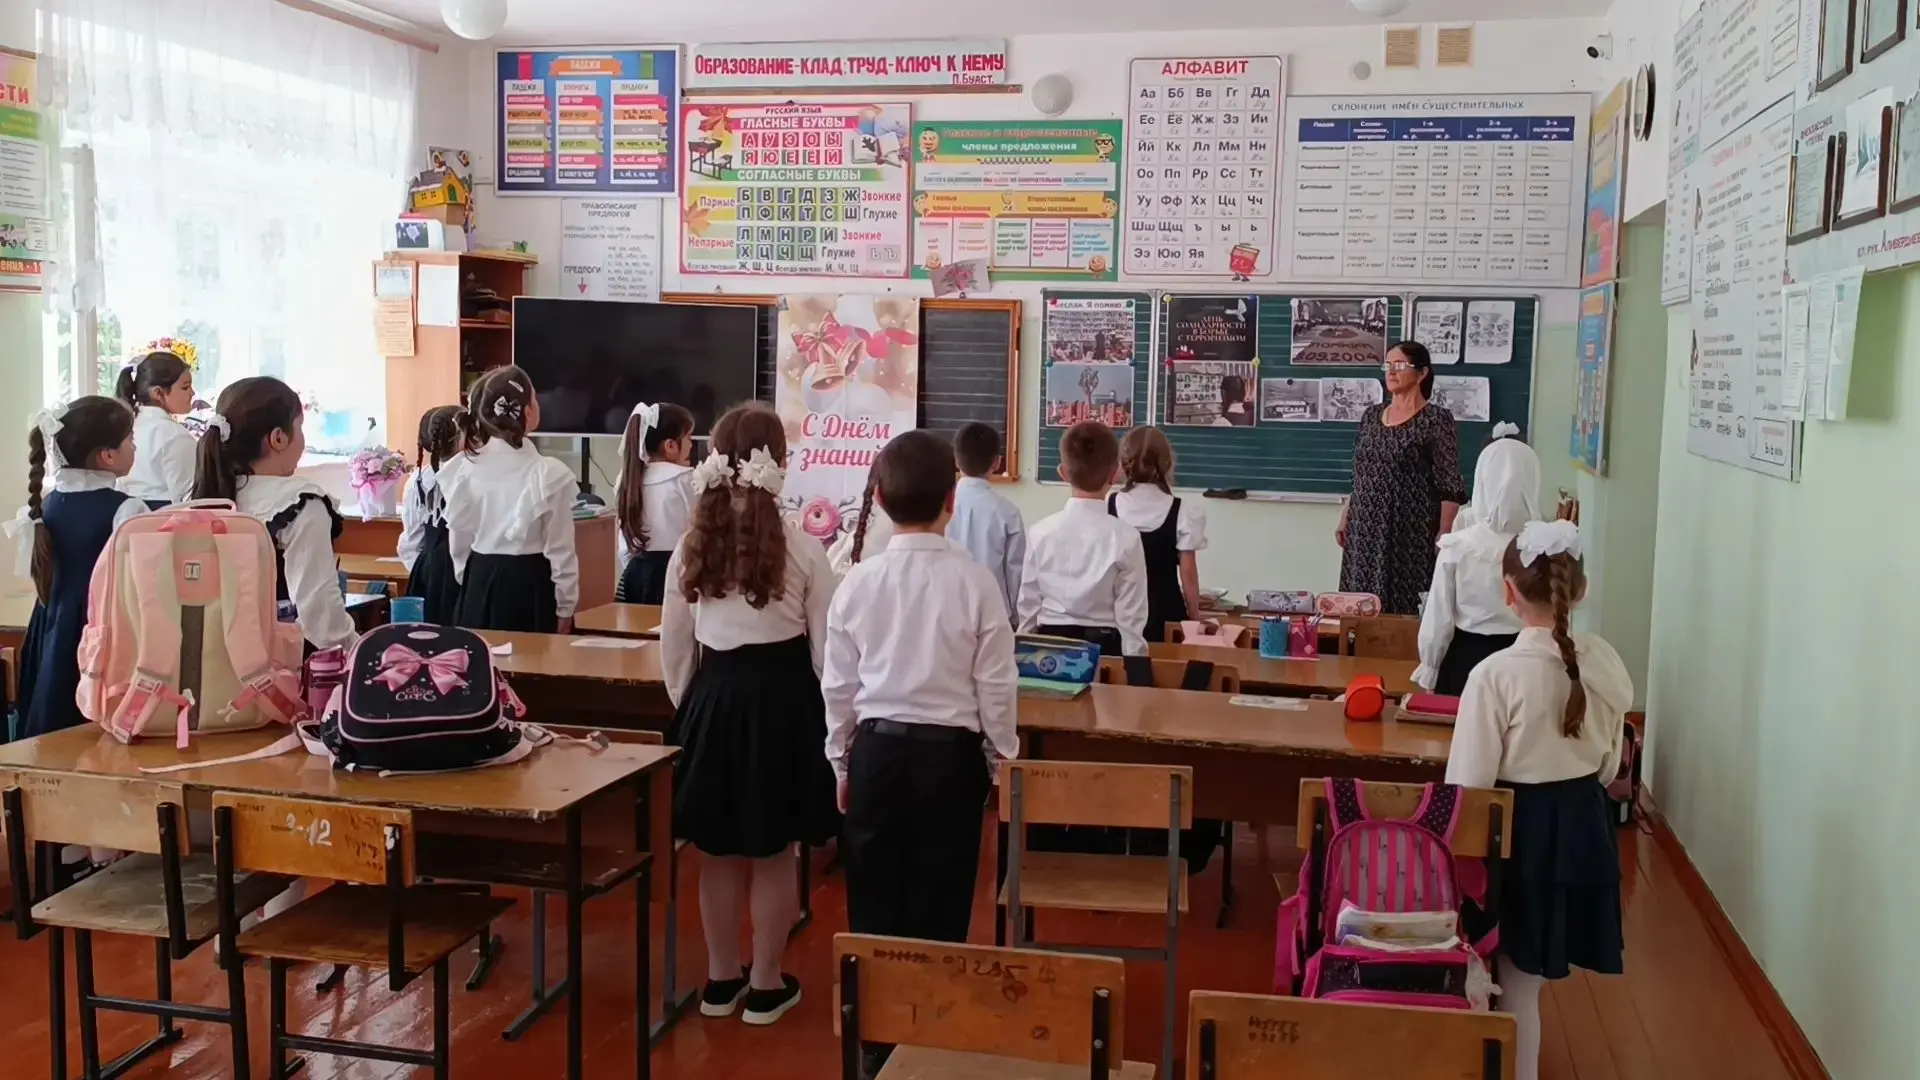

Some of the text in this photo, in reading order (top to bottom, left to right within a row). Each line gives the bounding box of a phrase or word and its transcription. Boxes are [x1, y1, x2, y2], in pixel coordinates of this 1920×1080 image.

[947, 54, 956, 72] К
[1161, 60, 1249, 76] АЛФАВИТ
[1140, 87, 1270, 99] Аа Бб Вв Гг Дд
[765, 107, 799, 115] РУССКИЙ
[1331, 101, 1524, 111] СКЛОНЕНИЕ ИМЁН СУЩЕСТВИТЕЛЬНЫХ
[740, 117, 845, 129] ГЛАСНЫЕ БУКВЫ
[1140, 115, 1155, 124] Ее
[1191, 114, 1214, 124] Жж
[1223, 114, 1239, 124] Зз
[1251, 114, 1268, 123] Ии
[961, 143, 1077, 152] члены предложения
[1167, 141, 1181, 151] Кк
[1193, 141, 1210, 151] Лл
[1219, 141, 1240, 151] Мм
[1249, 141, 1266, 151] Нн
[737, 169, 861, 181] СОГЛАСНЫЕ БУКВЫ
[1137, 168, 1263, 180] Оо Пп Рр Сс Тт
[844, 189, 858, 202] Ж
[861, 189, 902, 202] Звонкие
[1137, 195, 1262, 207] Уу Фф Хх Цц Чч
[581, 202, 637, 210] ПРАВОПИСАНИЕ
[700, 195, 736, 209] Парные
[588, 210, 631, 218] ПРЕДЛОГОВ
[844, 207, 858, 220] Ш
[863, 207, 898, 222] Глухие
[1132, 221, 1155, 231] Шш
[1159, 222, 1183, 233] Щщ
[842, 229, 882, 241] Звонкие
[688, 237, 735, 250] Непарные
[800, 247, 814, 261] Щ
[821, 246, 856, 261] Глухие
[1134, 248, 1204, 258] Ээ Юю Яя
[563, 265, 601, 275] ПРЕДЛОГИ
[801, 413, 891, 440] С Днём
